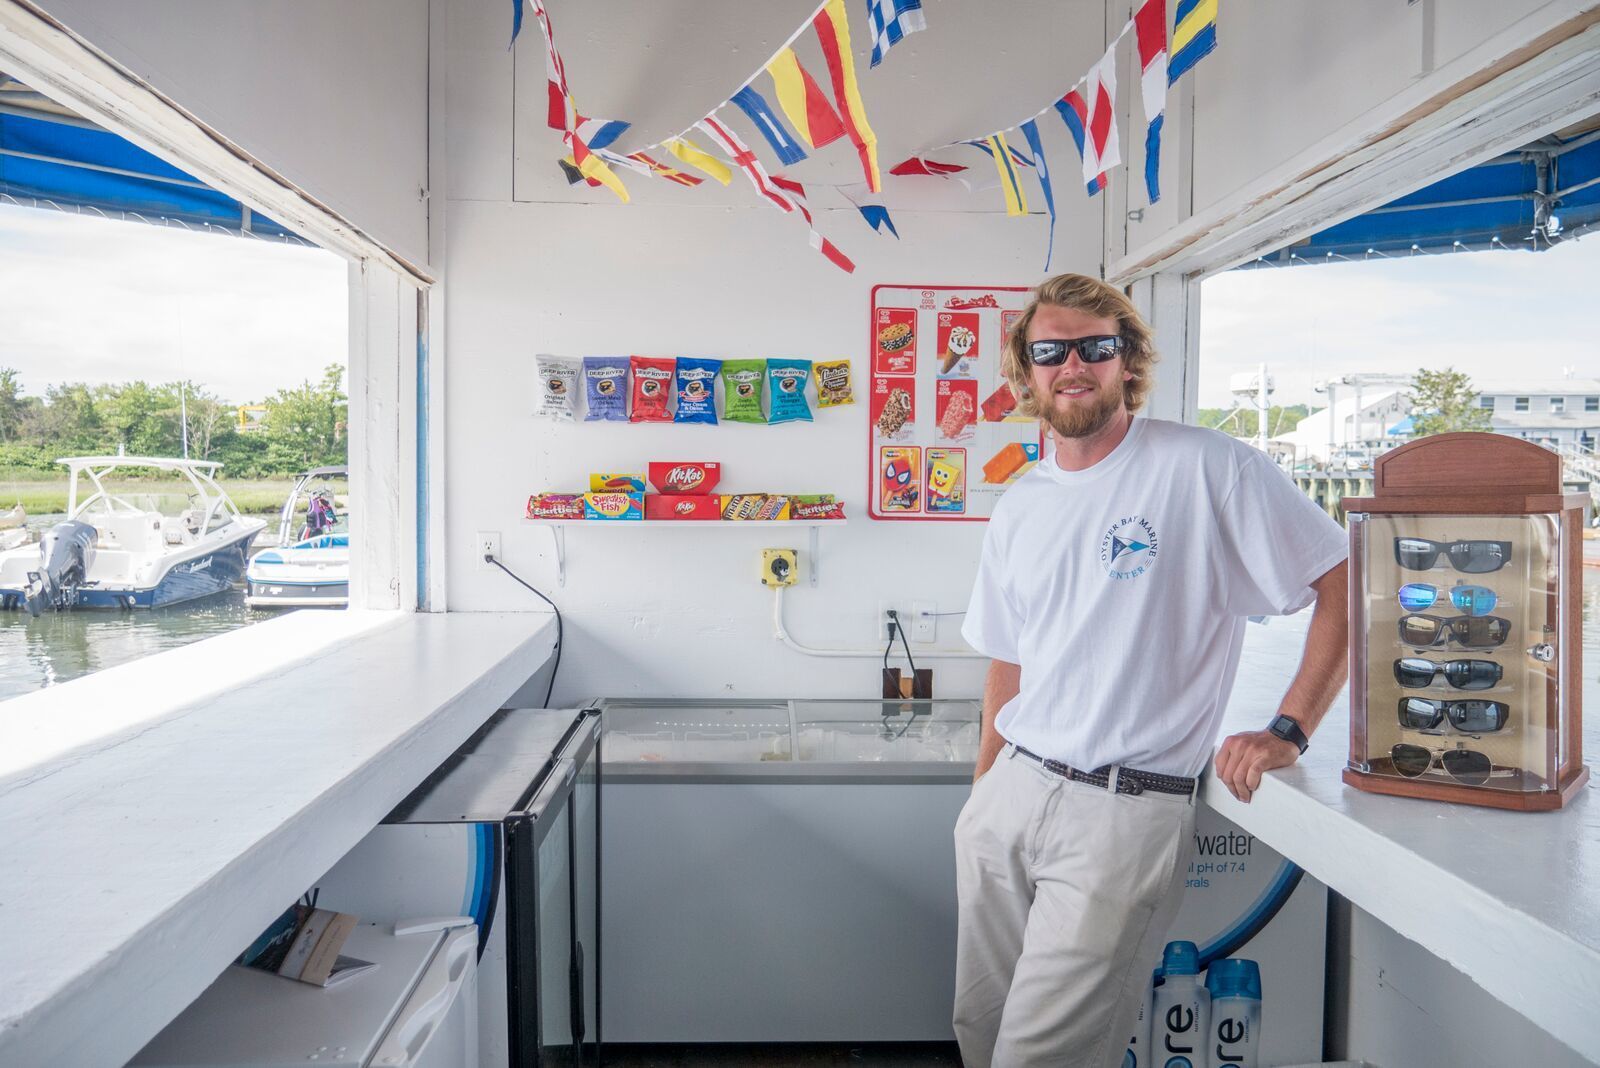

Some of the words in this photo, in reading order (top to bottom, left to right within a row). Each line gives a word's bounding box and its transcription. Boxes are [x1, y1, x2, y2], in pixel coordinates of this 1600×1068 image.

[592, 493, 628, 506] Swedish
[601, 502, 620, 512] Fish
[1101, 523, 1119, 561] OYSTER
[1121, 516, 1138, 526] BAY
[1138, 518, 1158, 557] MARINE
[1197, 831, 1256, 856] water
[1197, 862, 1214, 876] pH
[1216, 861, 1228, 873] of
[1230, 862, 1245, 873] 7.4
